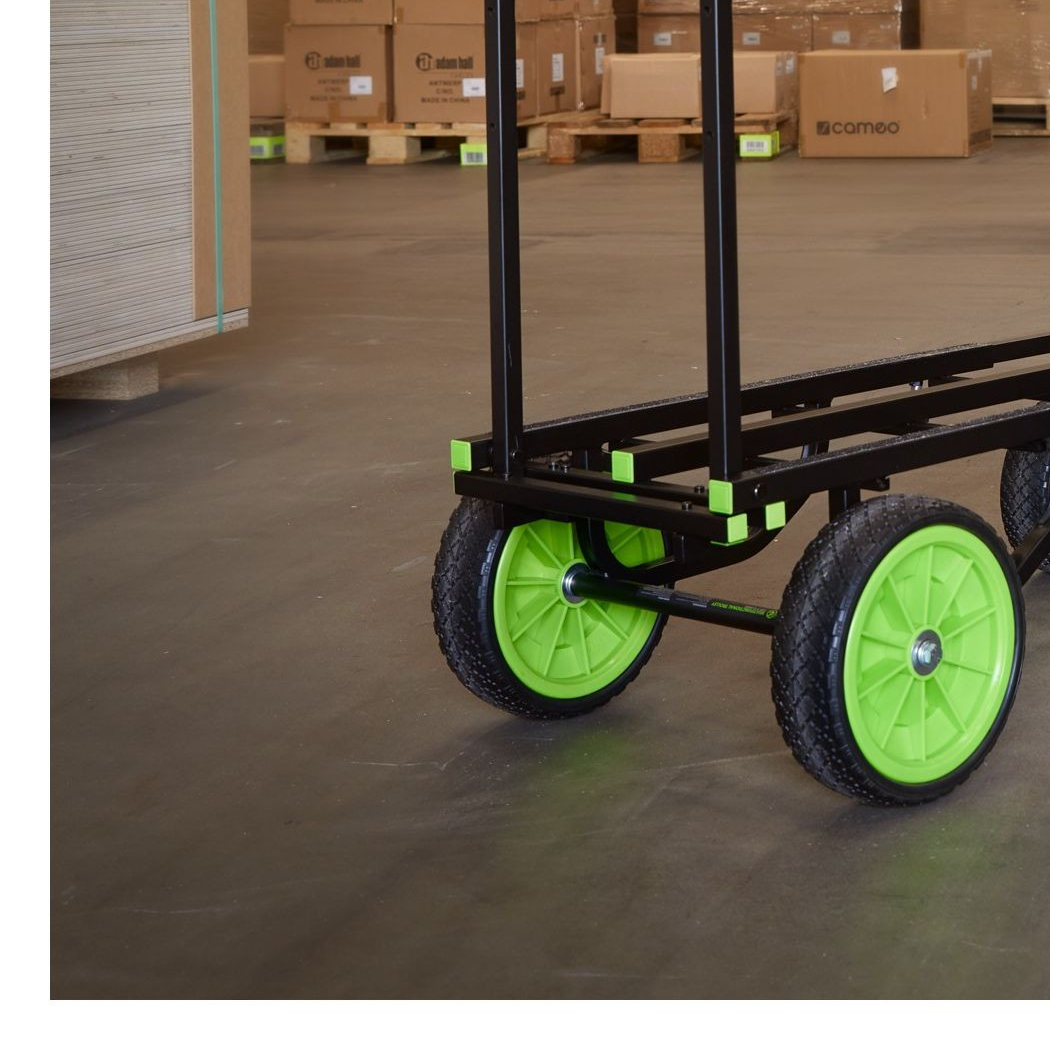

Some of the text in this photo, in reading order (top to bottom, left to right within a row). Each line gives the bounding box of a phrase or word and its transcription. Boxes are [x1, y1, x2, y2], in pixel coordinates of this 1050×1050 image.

[436, 55, 473, 70] adam hall
[831, 120, 900, 135] cameo
